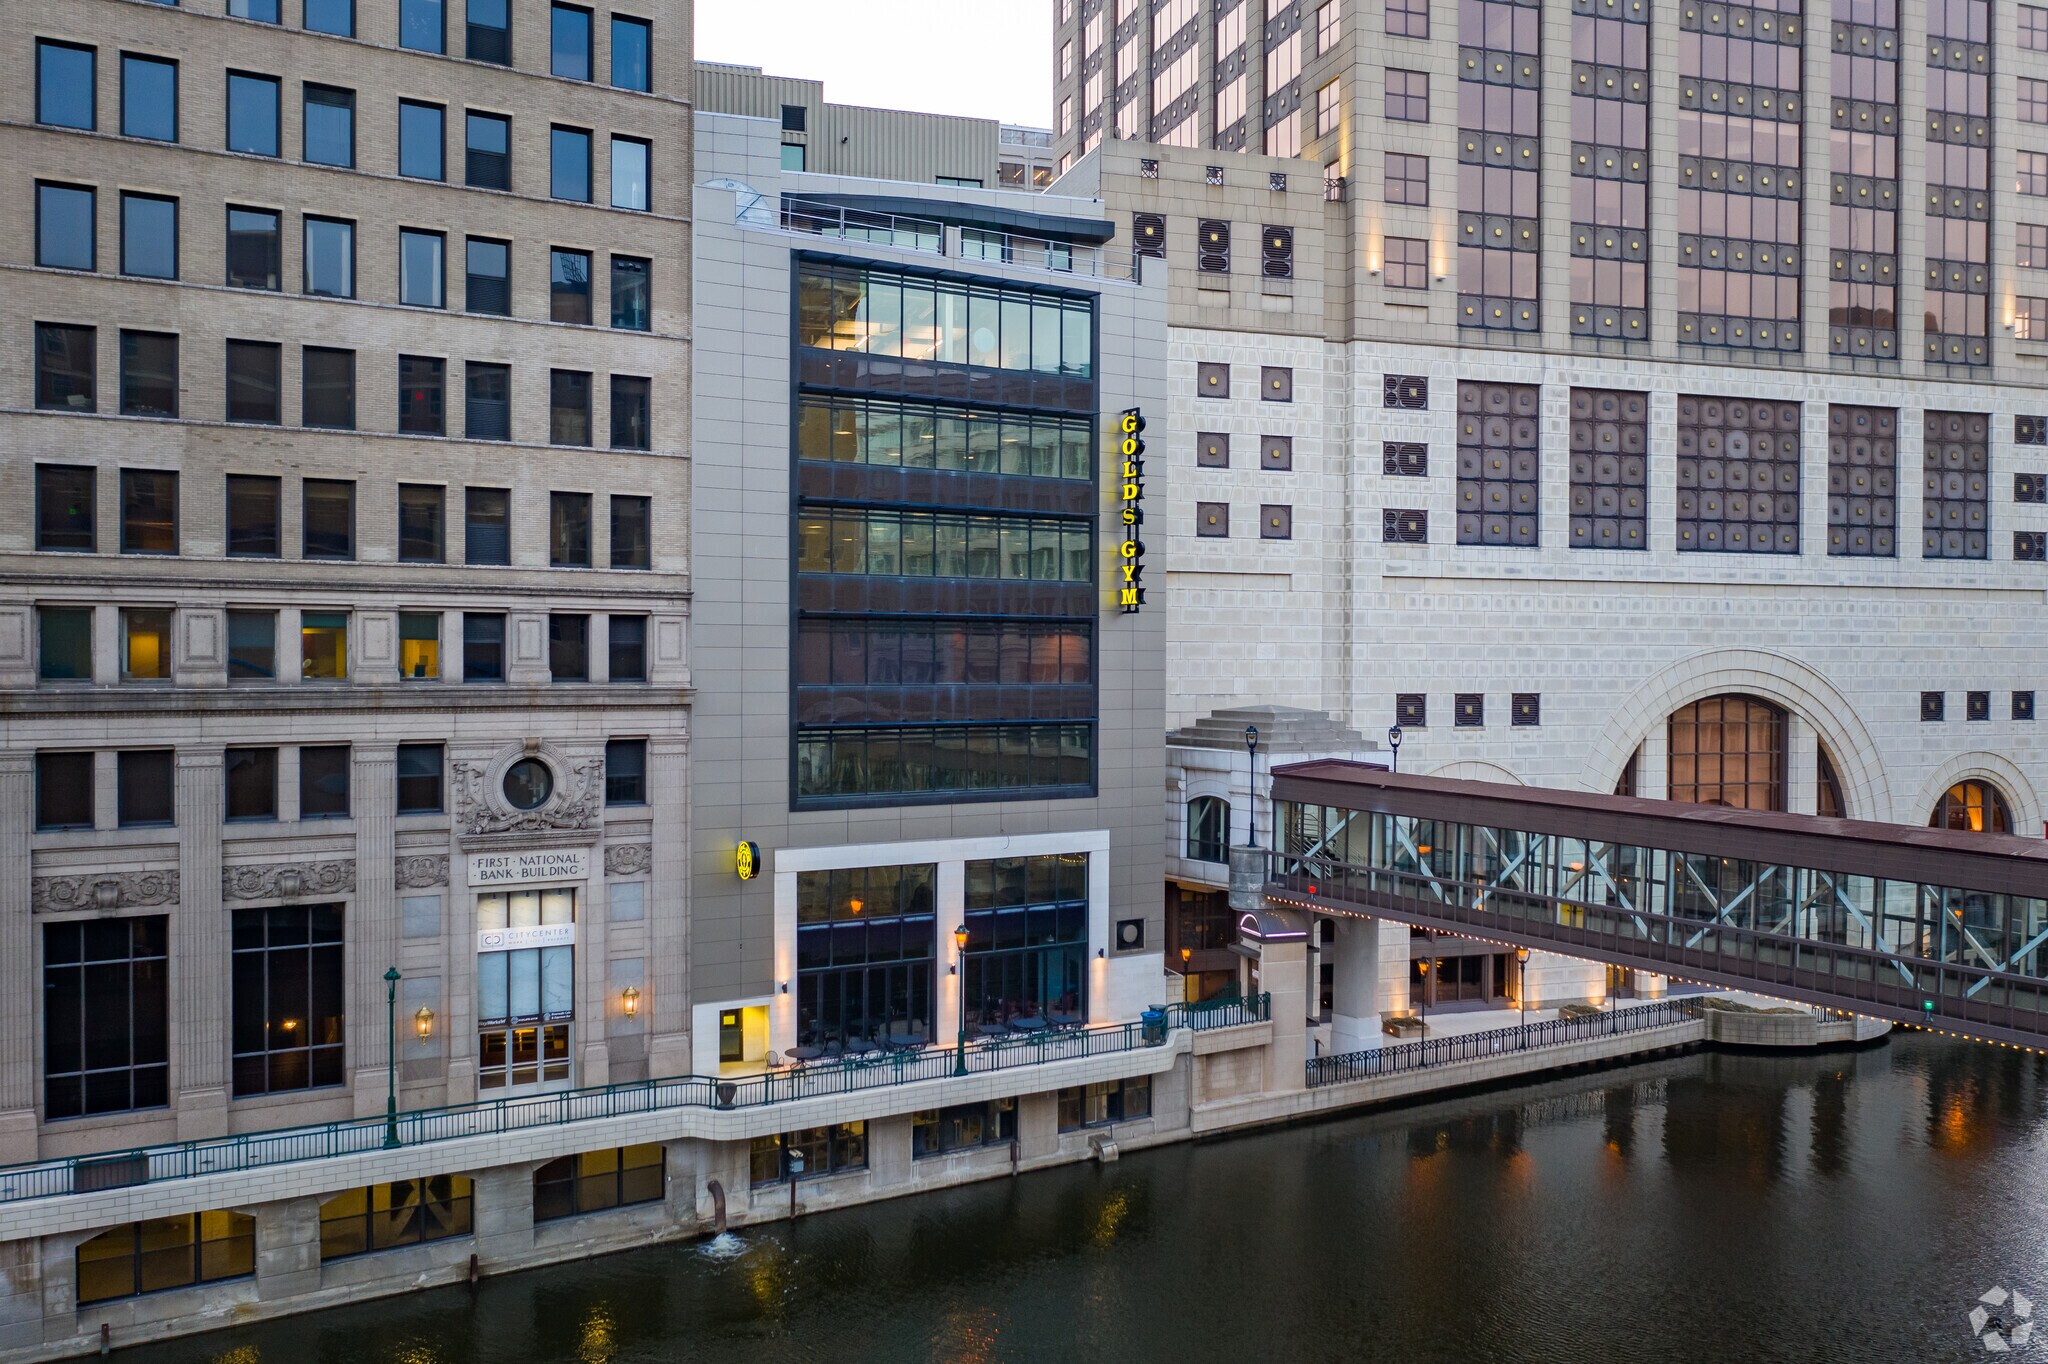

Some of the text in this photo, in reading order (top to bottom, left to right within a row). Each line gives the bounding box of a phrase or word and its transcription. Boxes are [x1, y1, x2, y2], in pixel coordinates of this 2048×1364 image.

[1120, 540, 1138, 605] GYM
[477, 854, 580, 868] FIRST NATIONAL
[480, 866, 578, 880] BANK BUILDING
[508, 928, 569, 940] CITYCENTER
